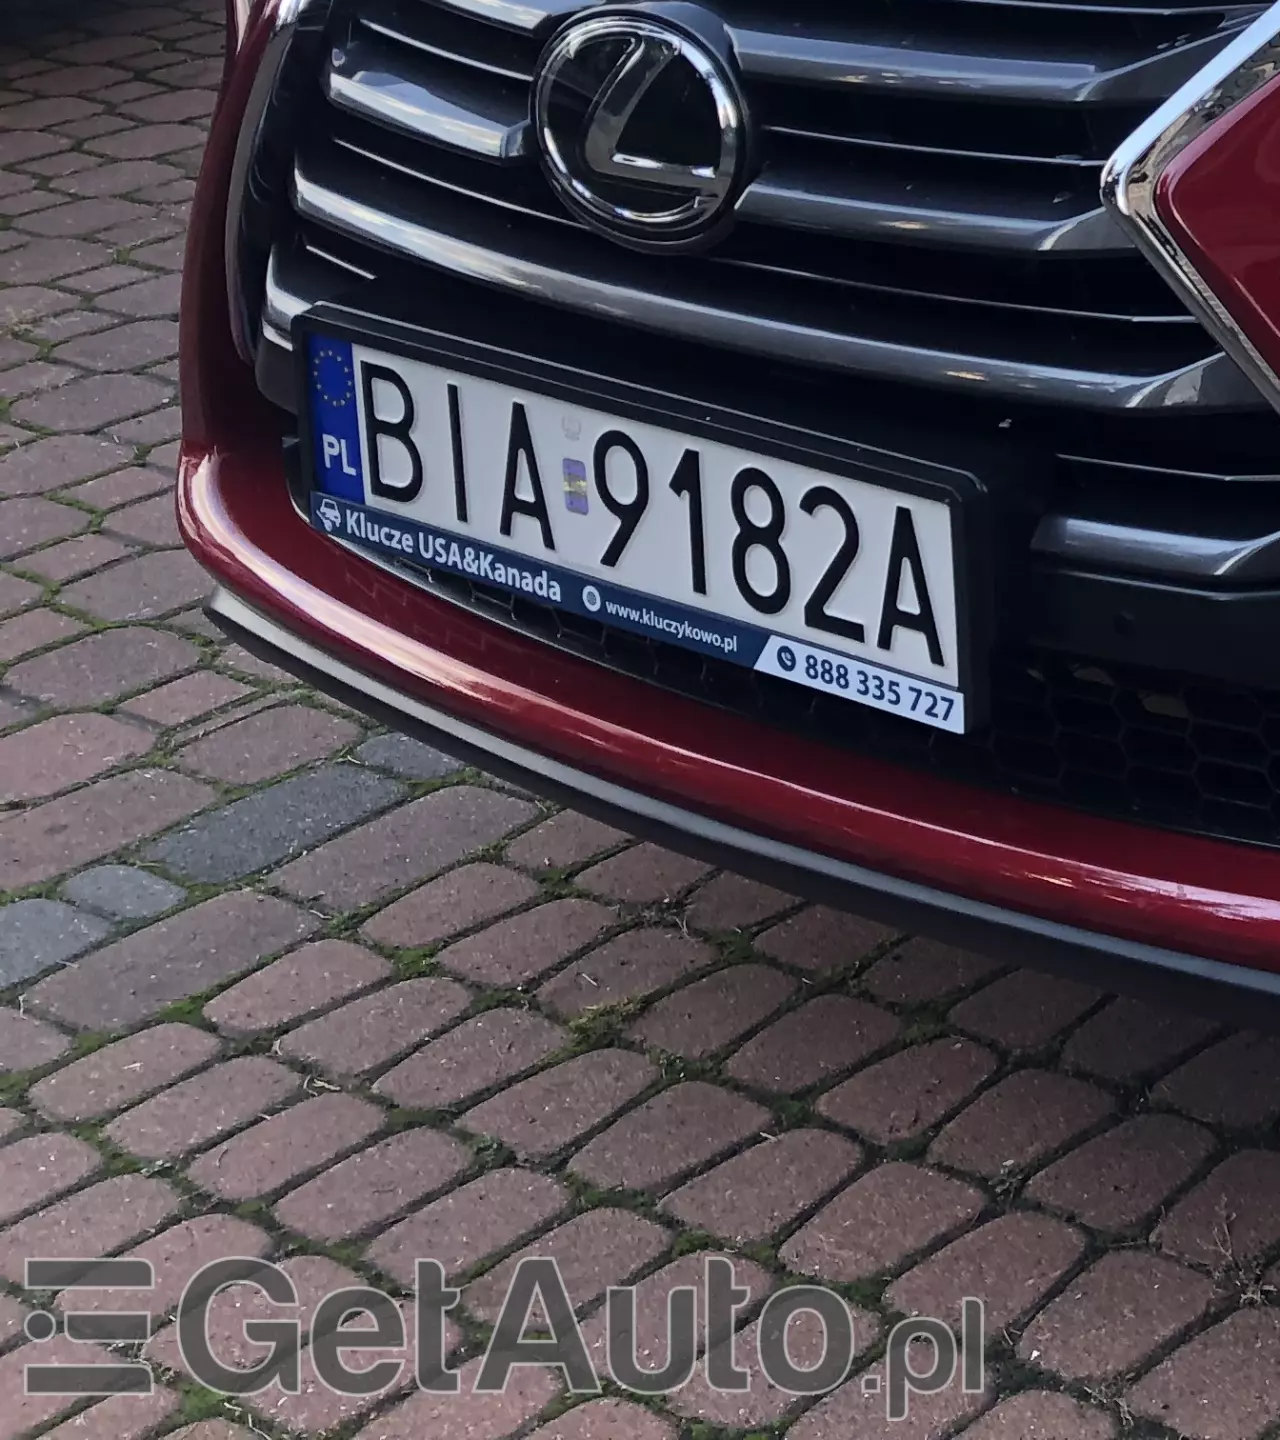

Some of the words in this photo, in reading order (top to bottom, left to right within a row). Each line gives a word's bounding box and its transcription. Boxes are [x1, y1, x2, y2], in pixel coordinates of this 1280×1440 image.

[321, 433, 357, 476] PL
[344, 508, 413, 554] Klucze
[418, 530, 562, 603] USA&Kanada
[605, 599, 738, 653] www.kluczykowo.pl
[804, 654, 850, 690] 888
[855, 669, 901, 706] 335
[907, 685, 955, 723] 727
